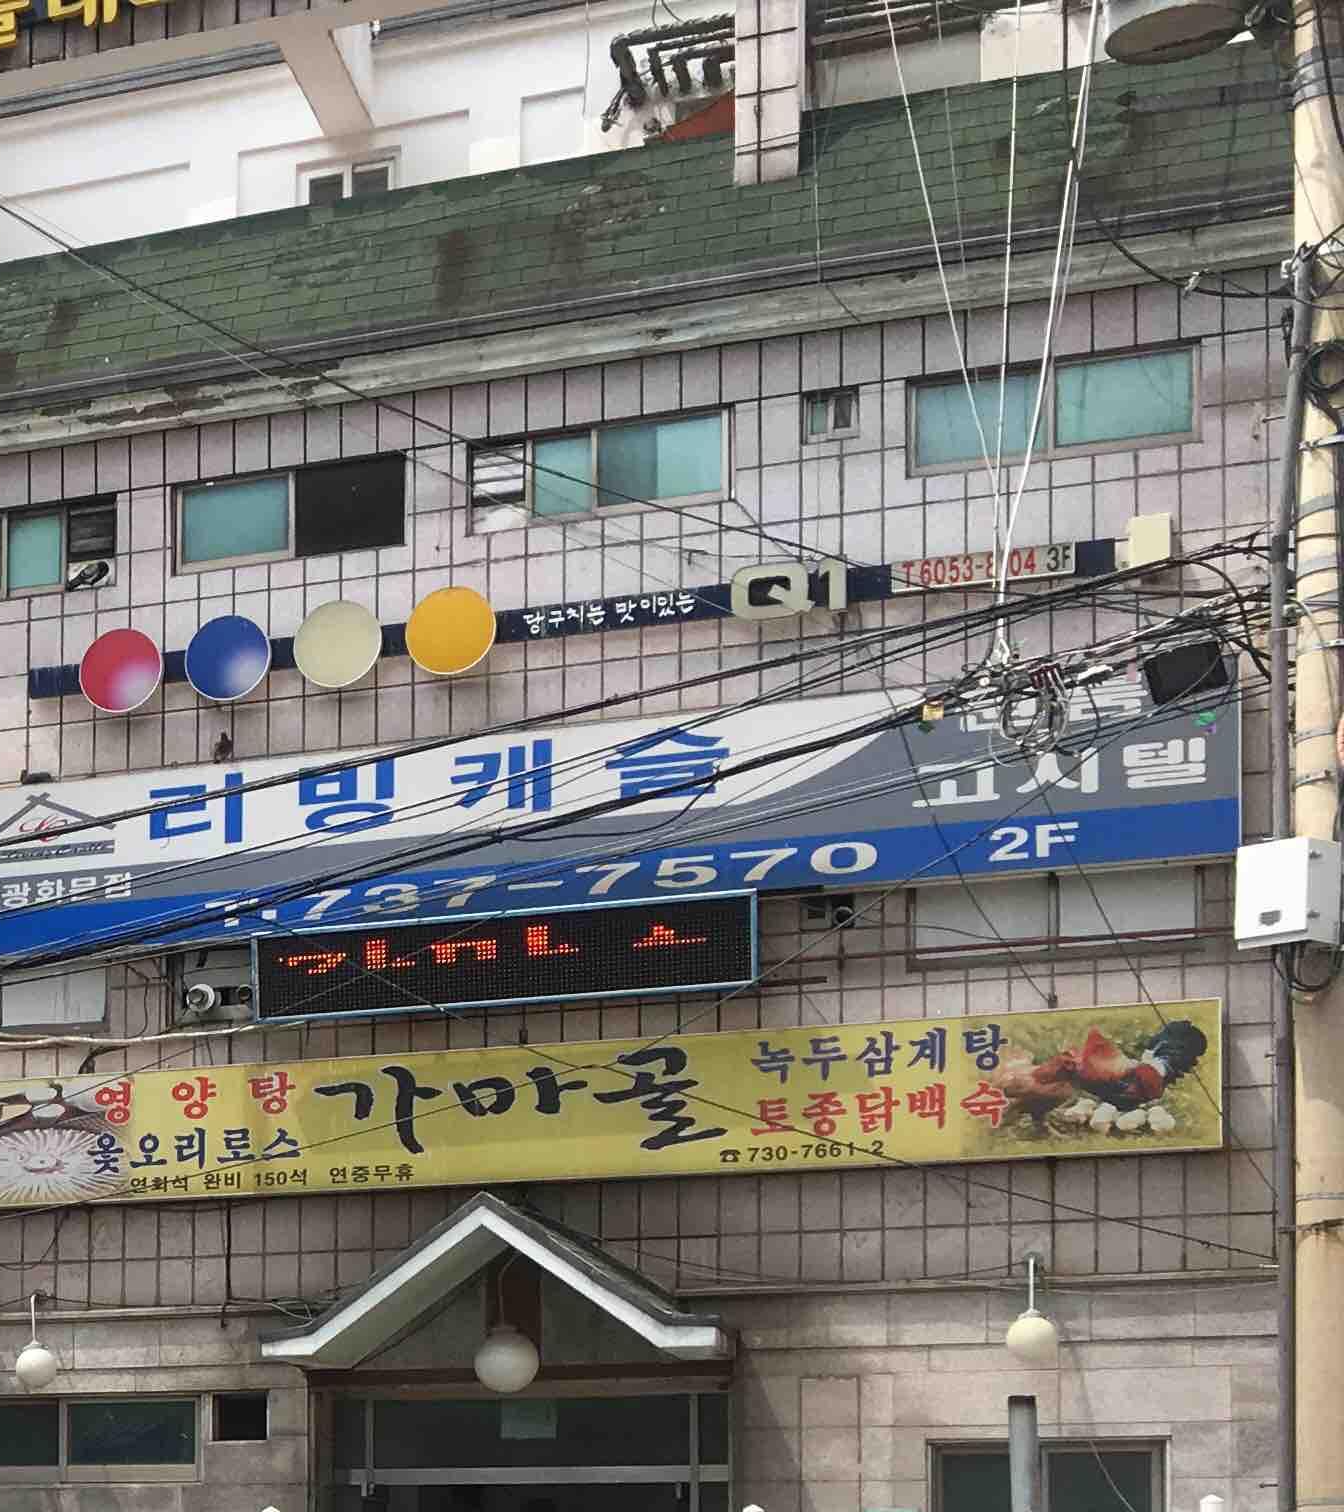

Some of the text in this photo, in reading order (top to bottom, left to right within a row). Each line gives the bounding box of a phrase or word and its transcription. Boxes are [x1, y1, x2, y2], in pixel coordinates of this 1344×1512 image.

[1046, 544, 1071, 571] 3F
[523, 604, 607, 635] 당구치는
[148, 727, 730, 844] 리빙캐슬
[912, 736, 1208, 809] 고시텔
[989, 821, 1081, 862] 2F
[0, 871, 133, 909] 광화문점
[750, 1023, 1009, 1084] 녹두삼계탕
[94, 1071, 297, 1126] 영양탕
[314, 1046, 729, 1155] 가마골
[750, 1080, 1009, 1137] 토종닭백숙
[203, 1170, 242, 1190] 완비
[254, 1168, 308, 1187] 150석
[328, 1163, 415, 1184] 연중무휴
